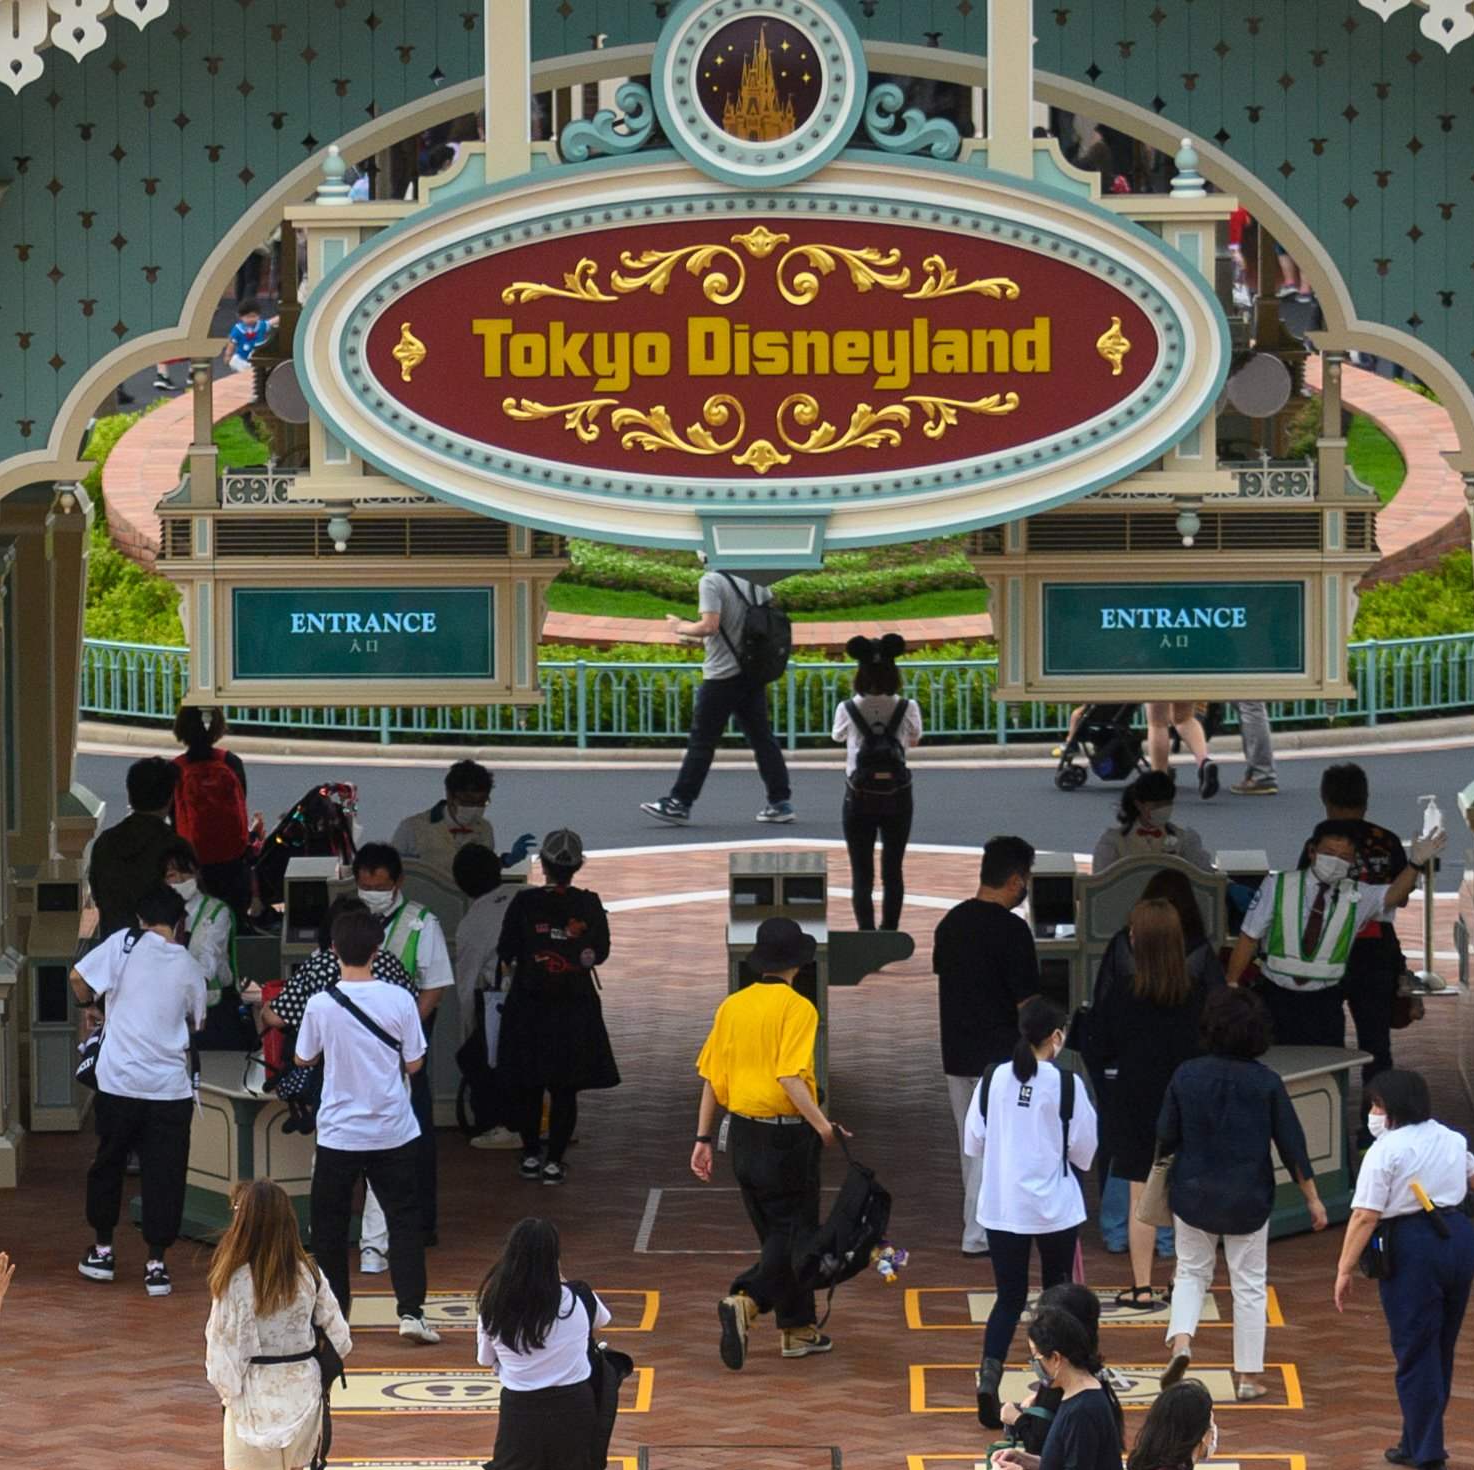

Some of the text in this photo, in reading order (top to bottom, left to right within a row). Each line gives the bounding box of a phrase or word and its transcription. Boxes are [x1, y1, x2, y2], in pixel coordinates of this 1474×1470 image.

[472, 316, 1051, 393] Tokyo Disneyland
[290, 612, 437, 634] ENTRANCE
[1100, 607, 1247, 629] ENTRANCE
[349, 638, 378, 653] 入口
[1159, 633, 1188, 649] 入口
